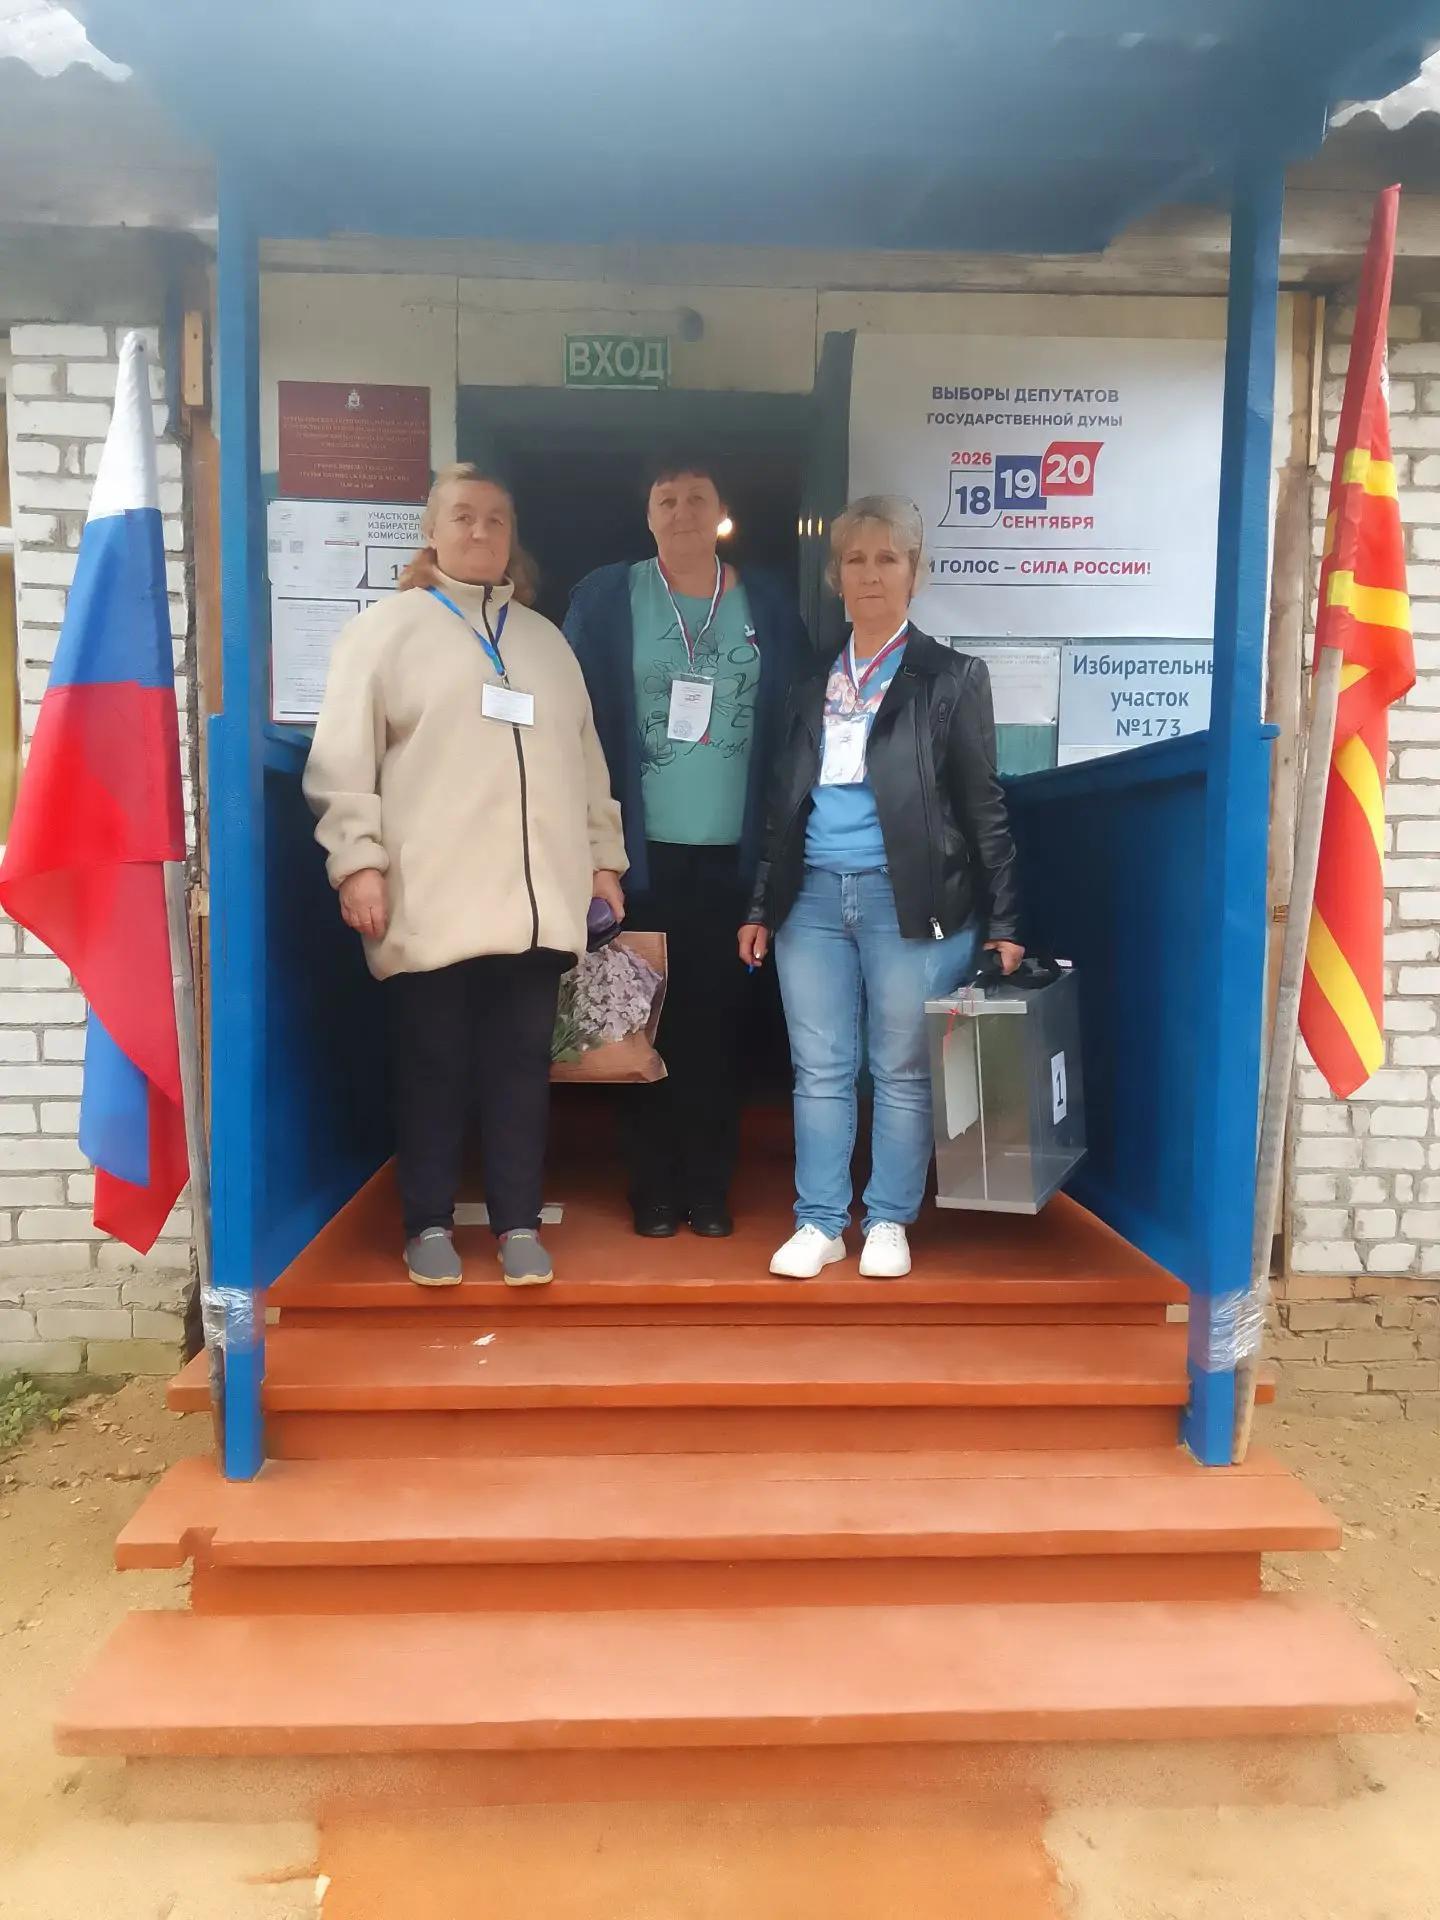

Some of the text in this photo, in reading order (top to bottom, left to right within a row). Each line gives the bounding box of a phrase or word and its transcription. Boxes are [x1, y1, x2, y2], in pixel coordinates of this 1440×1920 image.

[569, 341, 664, 380] ВХОД
[932, 386, 1119, 404] ВЫБОРЫ ДЕПУТАТОВ
[926, 412, 1122, 428] ГОСУДАРСТВЕННОЙ ДУМЫ
[951, 452, 992, 466] 2026
[955, 453, 1091, 516] 18 19 20
[368, 512, 422, 521] УЧАСТКОВА
[1002, 515, 1094, 530] СЕНТЯБРЯ
[368, 522, 422, 531] ИЗБИРАТЕЛ
[368, 532, 418, 541] КОМИССИЯ
[940, 560, 999, 574] ГОЛОС
[1020, 560, 1068, 574] СИЛА
[1074, 561, 1151, 575] РОССИИ!
[1111, 690, 1190, 712] участок
[1116, 718, 1182, 738] №173
[1056, 1071, 1064, 1107] 1
